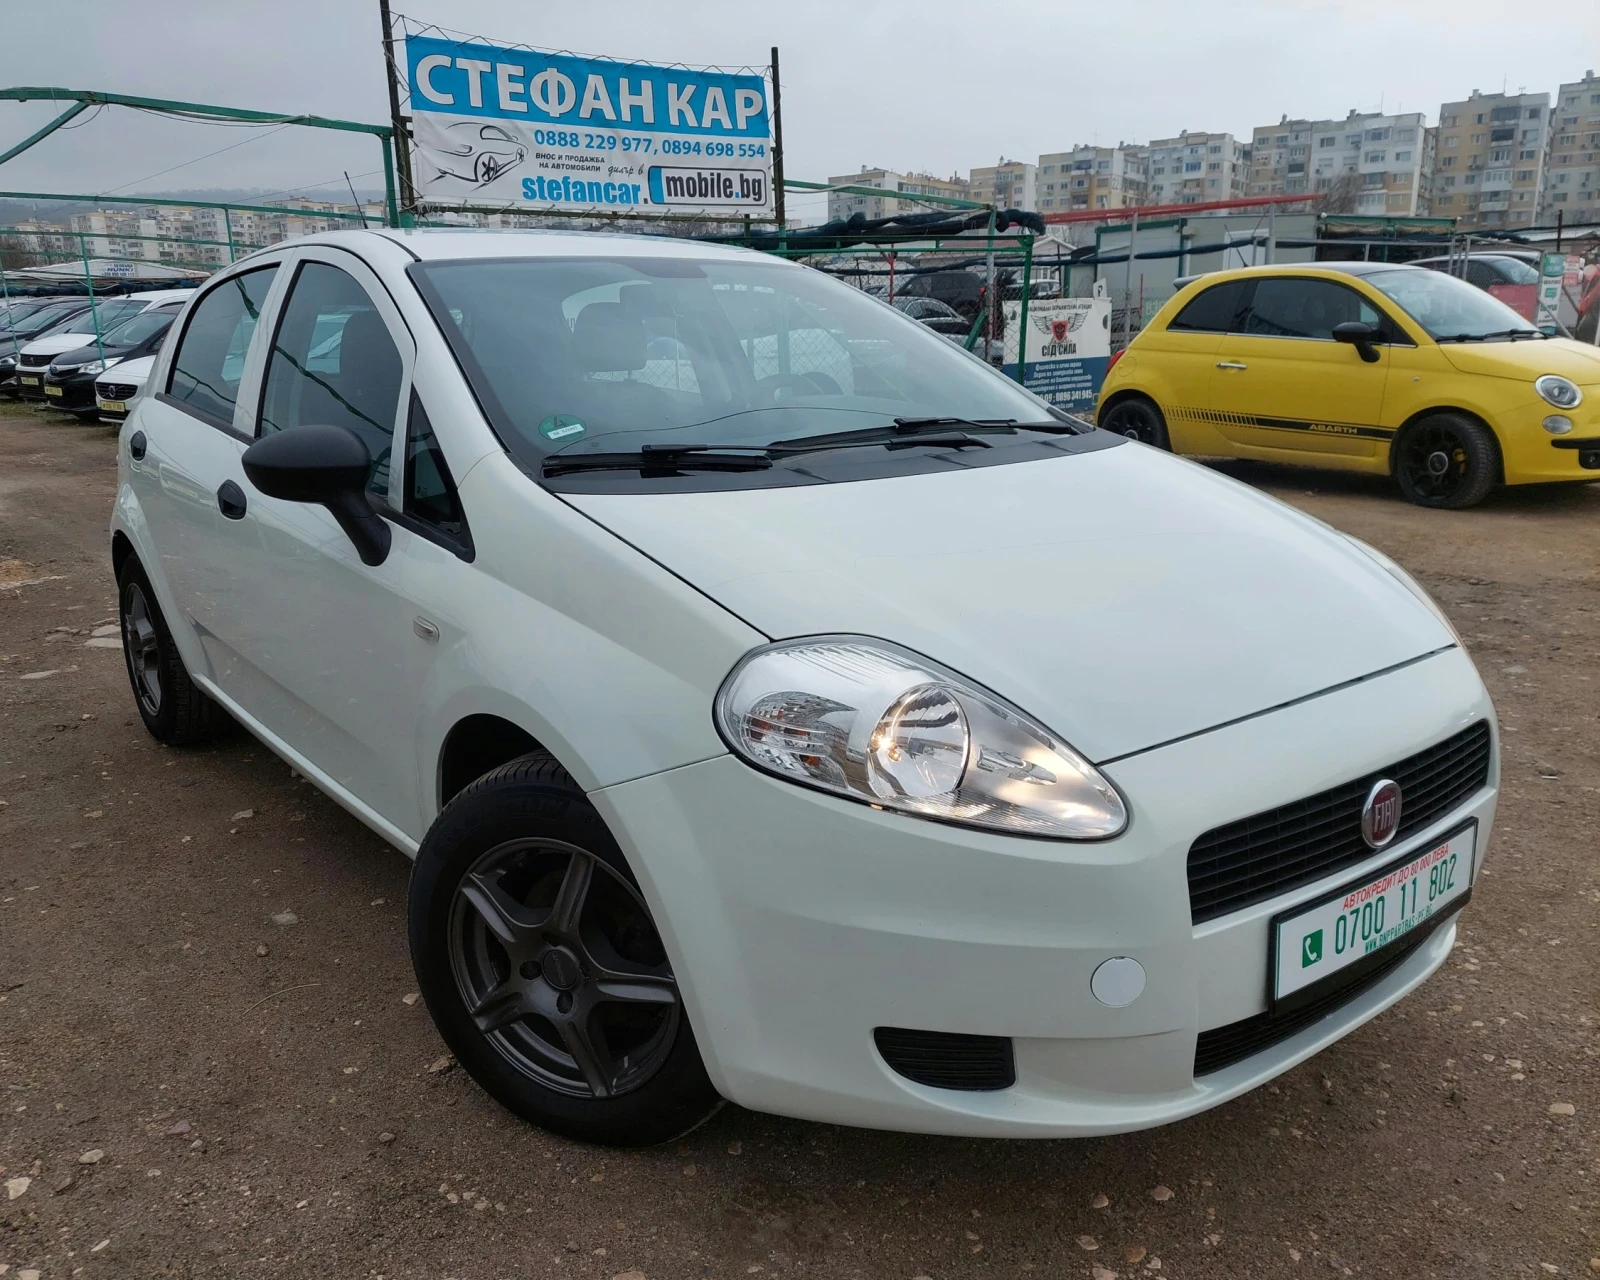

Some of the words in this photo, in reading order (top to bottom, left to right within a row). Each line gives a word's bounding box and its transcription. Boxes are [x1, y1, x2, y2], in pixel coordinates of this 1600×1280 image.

[414, 53, 656, 124] СТЕФАН
[667, 82, 765, 131] КАР
[534, 129, 580, 148] 0888
[584, 133, 617, 150] 229
[622, 137, 658, 155] 977,
[662, 139, 702, 155] 0894
[706, 142, 734, 157] 698
[739, 143, 765, 158] 554
[535, 152, 556, 160] ВНОС
[565, 154, 605, 164] ПРОДАЖБА
[551, 163, 601, 172] АВТОМОБИЛИ
[665, 171, 763, 202] mobile.bg
[1309, 423, 1358, 434] ABARTH
[1374, 797, 1396, 833] FIAT
[1343, 872, 1397, 911] АВТОКРЕДИТ
[1397, 866, 1409, 885] ДО
[1431, 843, 1449, 864] ЛЕВА
[1335, 895, 1385, 955] 0700
[1401, 877, 1417, 920] 11
[1429, 853, 1457, 902] 802
